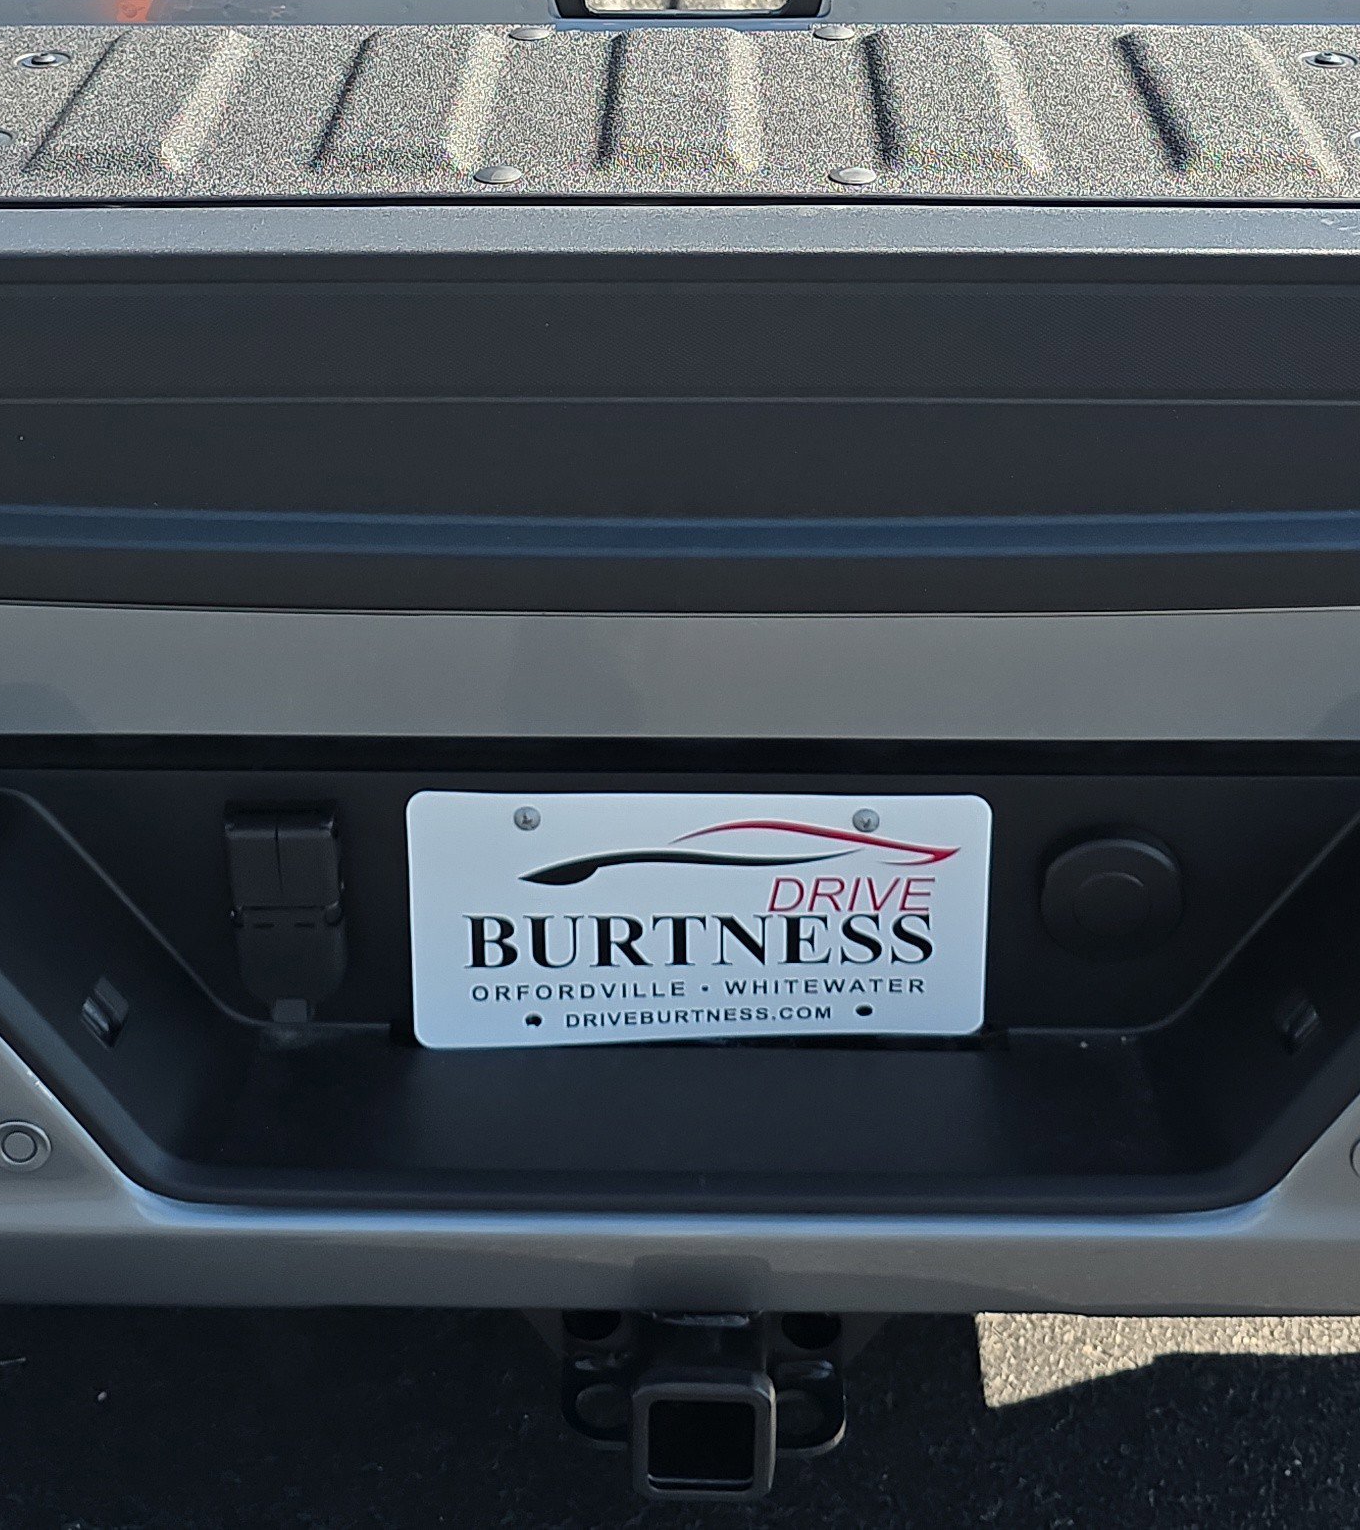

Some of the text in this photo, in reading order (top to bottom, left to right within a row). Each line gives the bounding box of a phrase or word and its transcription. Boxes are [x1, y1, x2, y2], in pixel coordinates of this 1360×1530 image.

[767, 876, 936, 912] DRIVE
[462, 913, 934, 969] BURTNESS
[471, 978, 926, 1002] ORFORDVILLE WHITEWATER
[565, 1006, 832, 1028] DRIVEBURTNESS.COM
